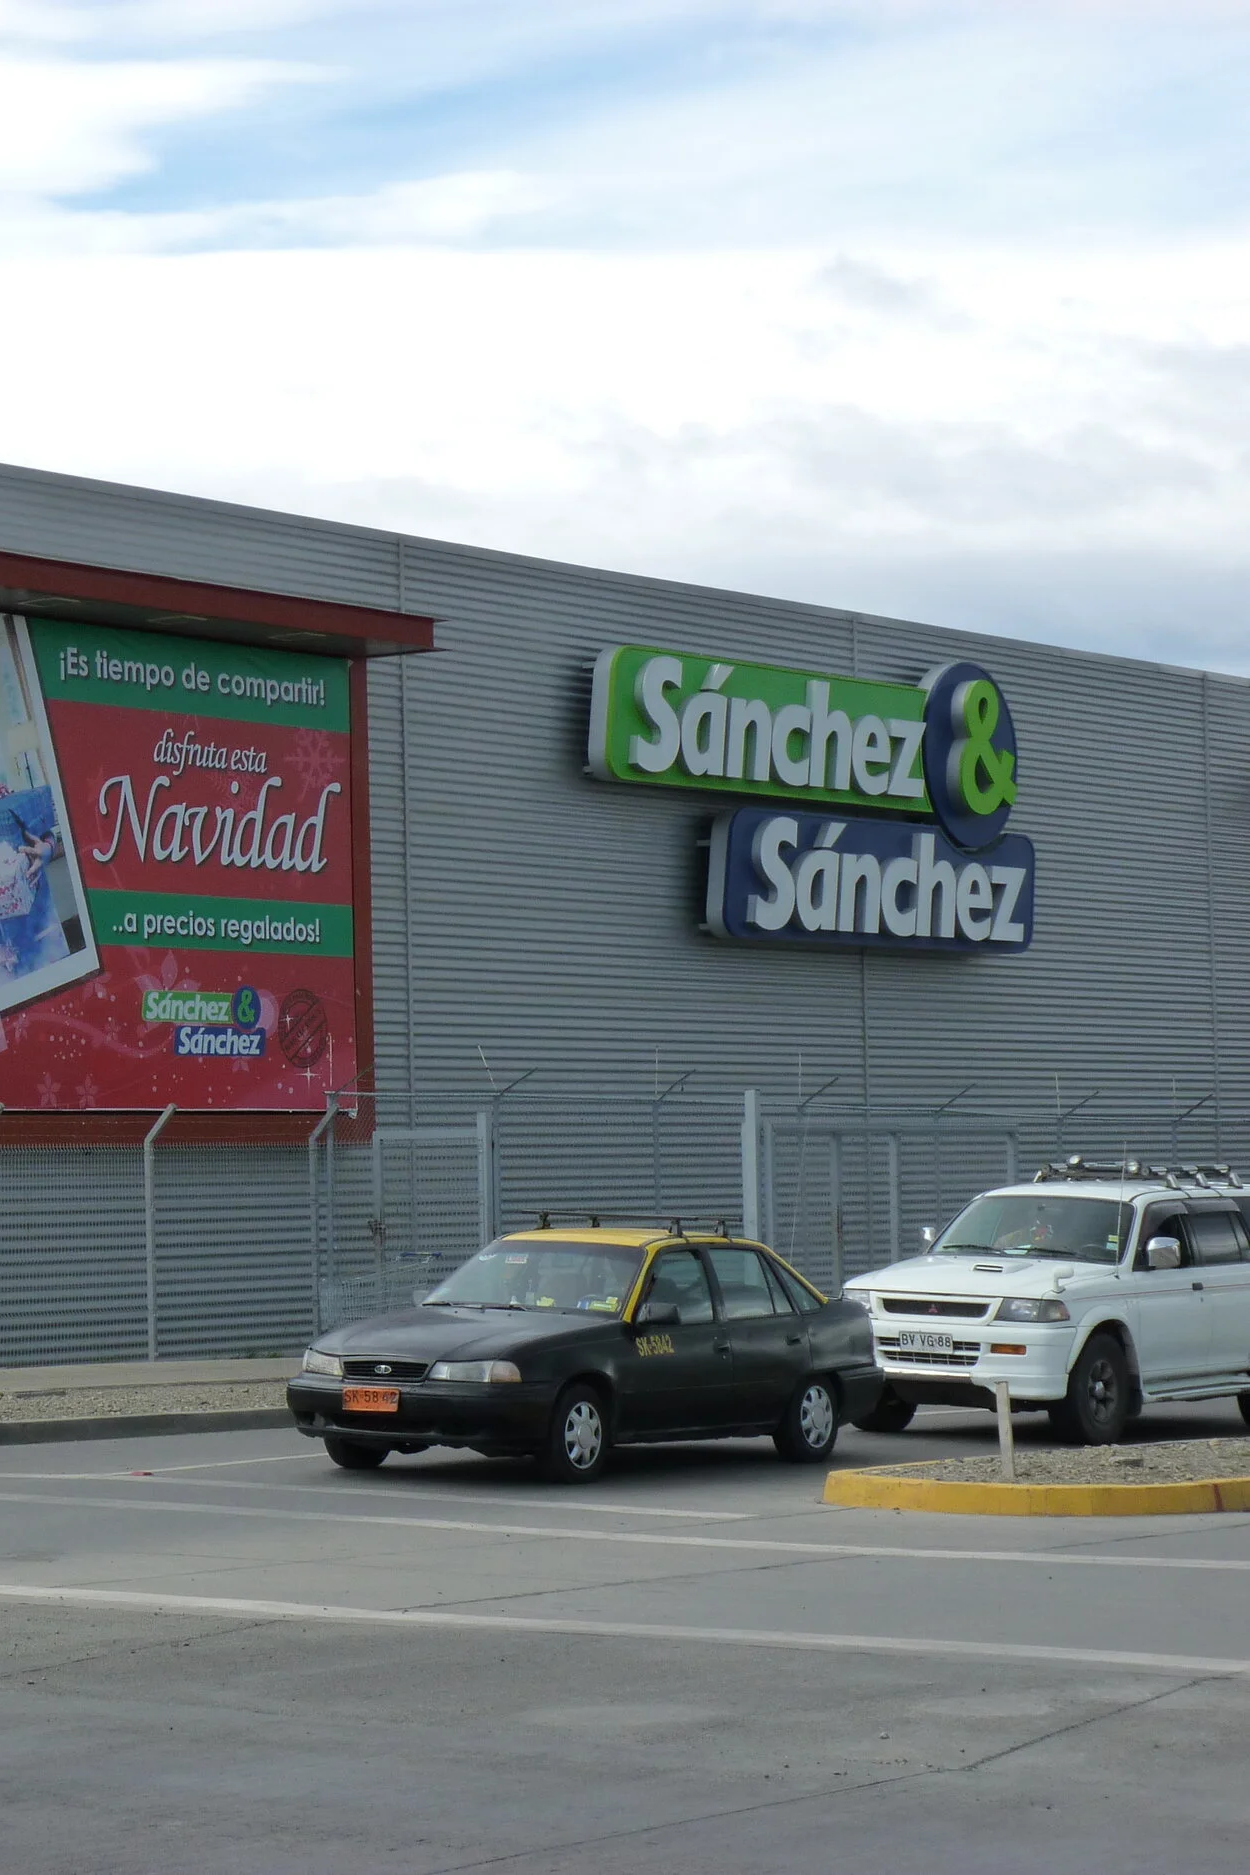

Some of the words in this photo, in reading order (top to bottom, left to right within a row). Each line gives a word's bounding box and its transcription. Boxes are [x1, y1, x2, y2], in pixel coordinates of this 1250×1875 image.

[60, 647, 89, 680] ¡Es
[96, 651, 175, 690] tiempo
[182, 662, 210, 692] de
[217, 671, 325, 706] compartir!
[153, 728, 228, 775] disfruta
[231, 746, 267, 773] esta
[629, 656, 926, 798] Sánchez
[950, 679, 1019, 816] &
[93, 774, 342, 874] Navidad
[747, 816, 1027, 942] Sánchez
[143, 910, 216, 939] precios
[220, 917, 321, 945] regalados!
[145, 990, 230, 1022] Sánchez
[237, 990, 255, 1022] &
[177, 1026, 261, 1055] Sánchez
[901, 1333, 915, 1346] BV
